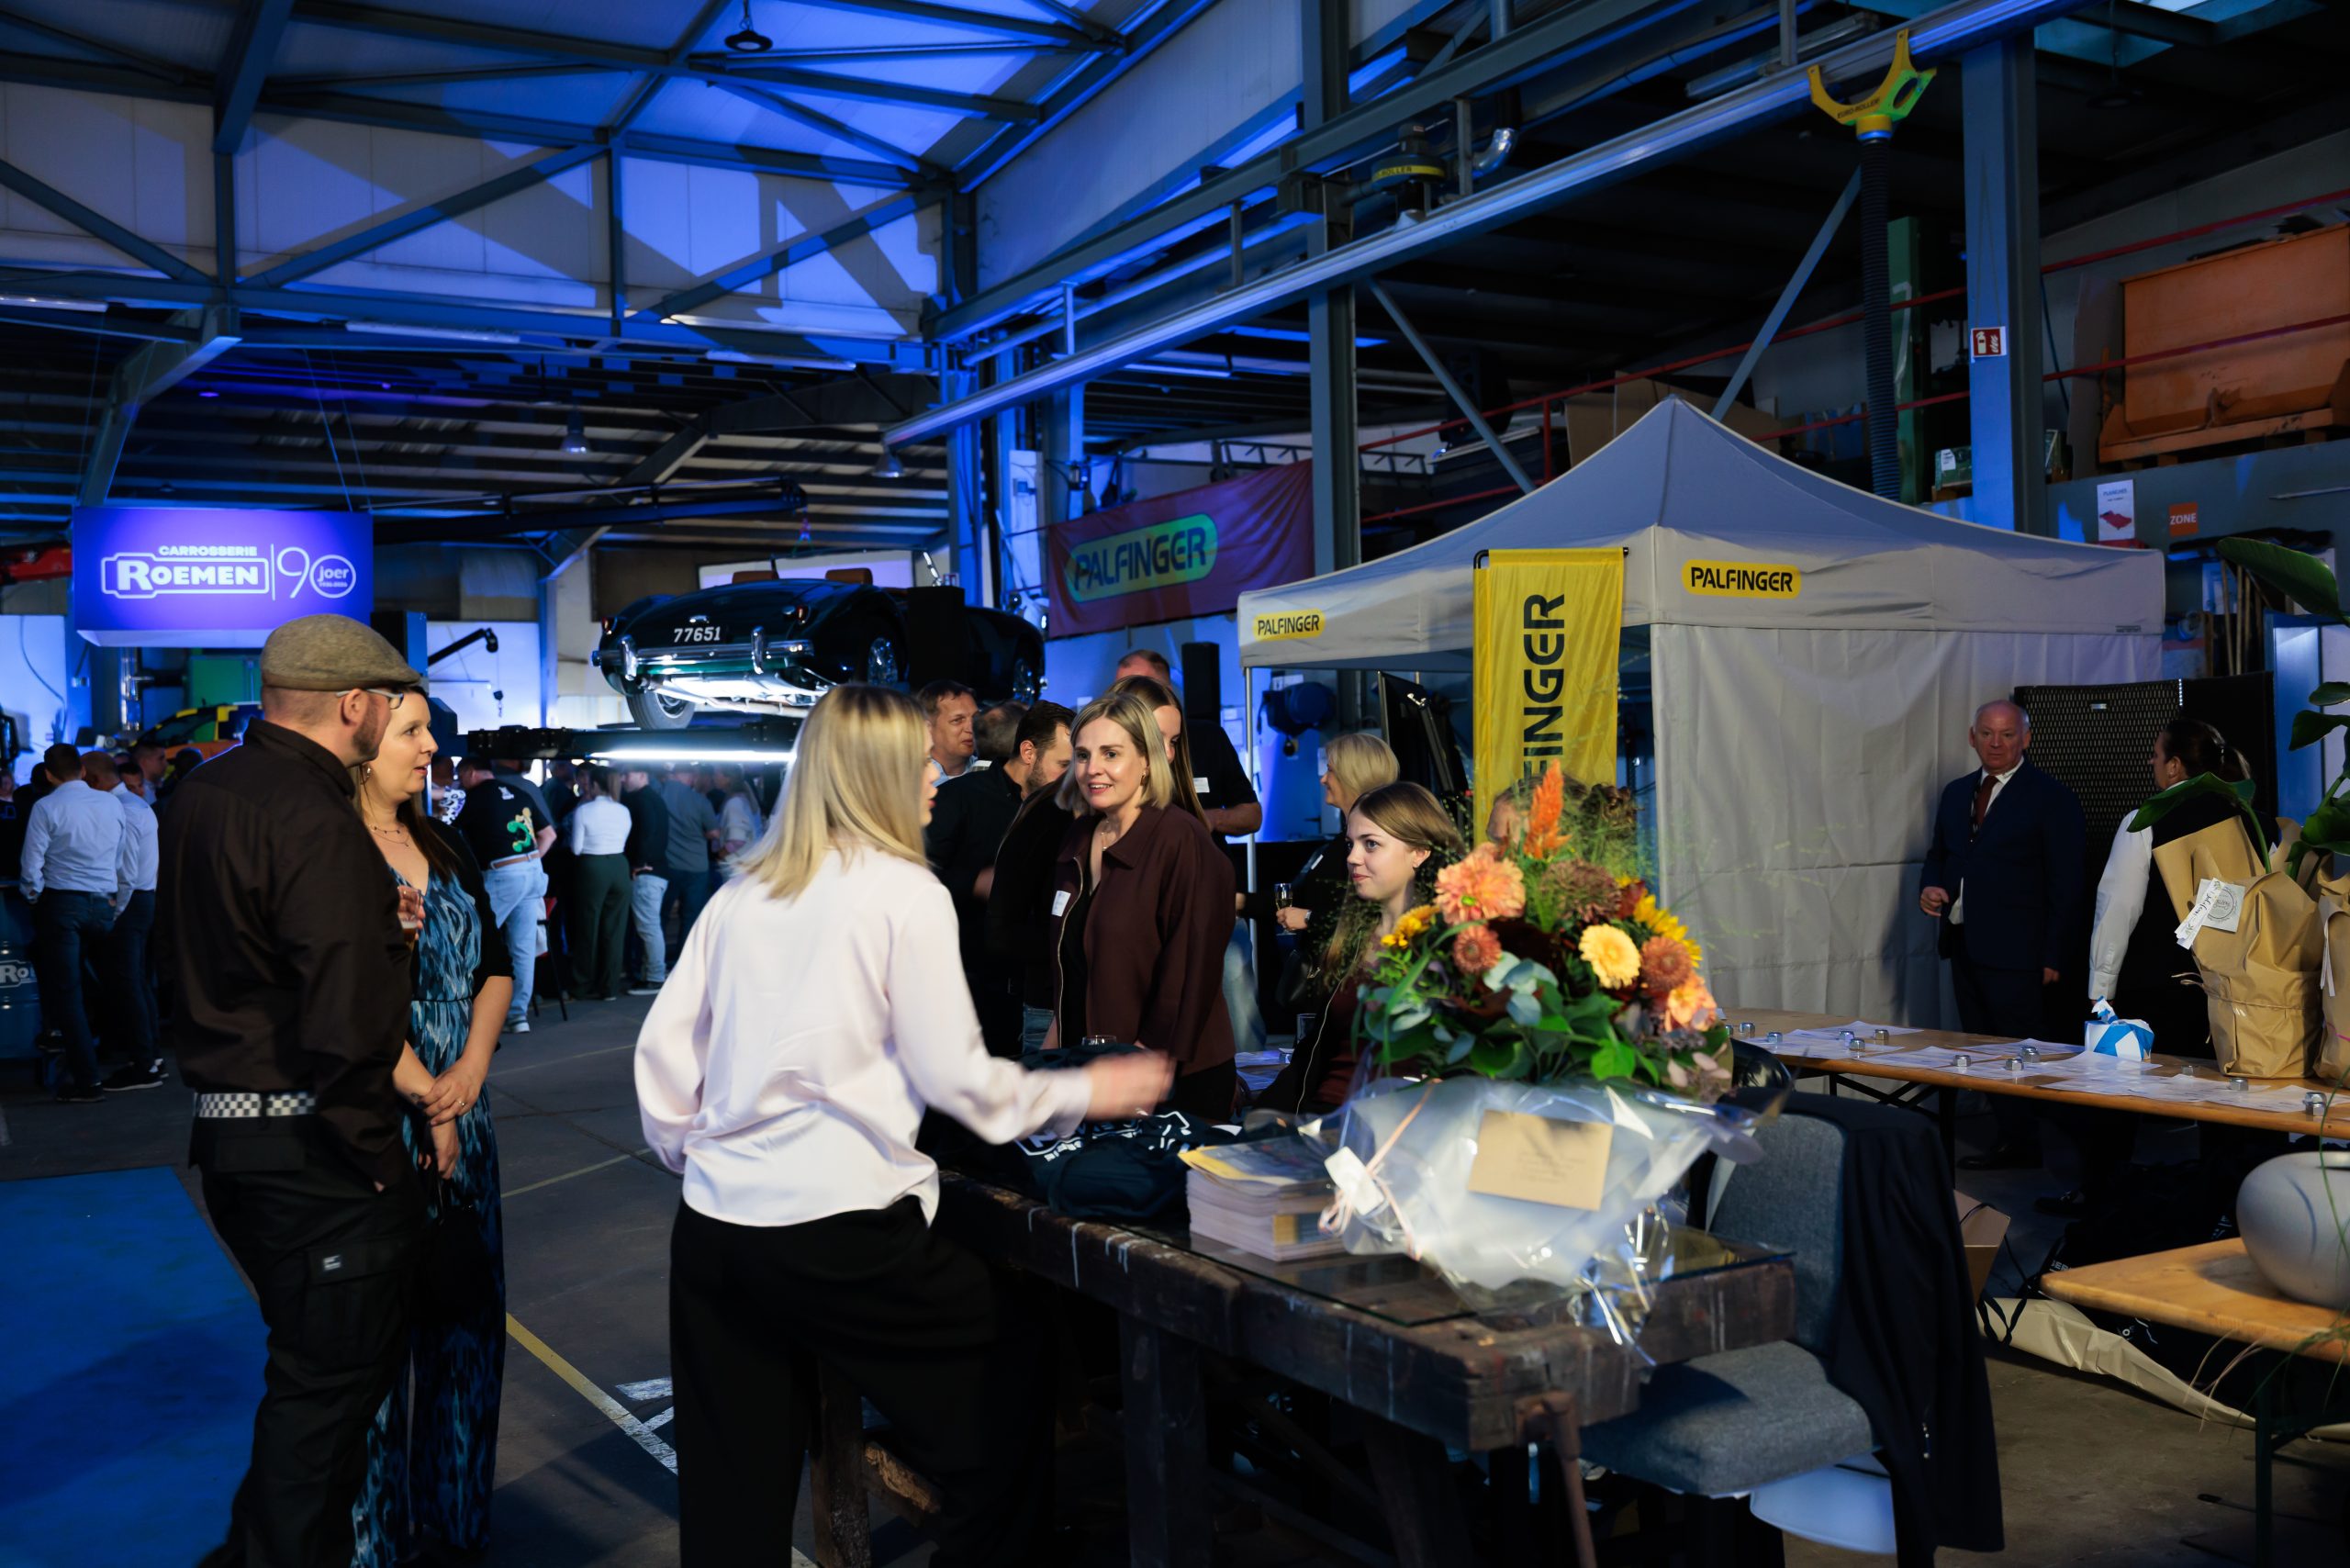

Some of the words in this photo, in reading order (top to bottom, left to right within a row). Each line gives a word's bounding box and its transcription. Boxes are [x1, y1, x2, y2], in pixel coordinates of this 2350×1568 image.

[2170, 513, 2197, 524] ZONE
[158, 545, 258, 556] CARROSSERIE
[1074, 527, 1206, 591] PALFINGER
[117, 560, 259, 590] ROEMEN
[317, 565, 350, 582] joer
[1691, 566, 1793, 592] PALFINGER
[674, 626, 721, 643] 77651
[1258, 614, 1320, 636] PALFINGER
